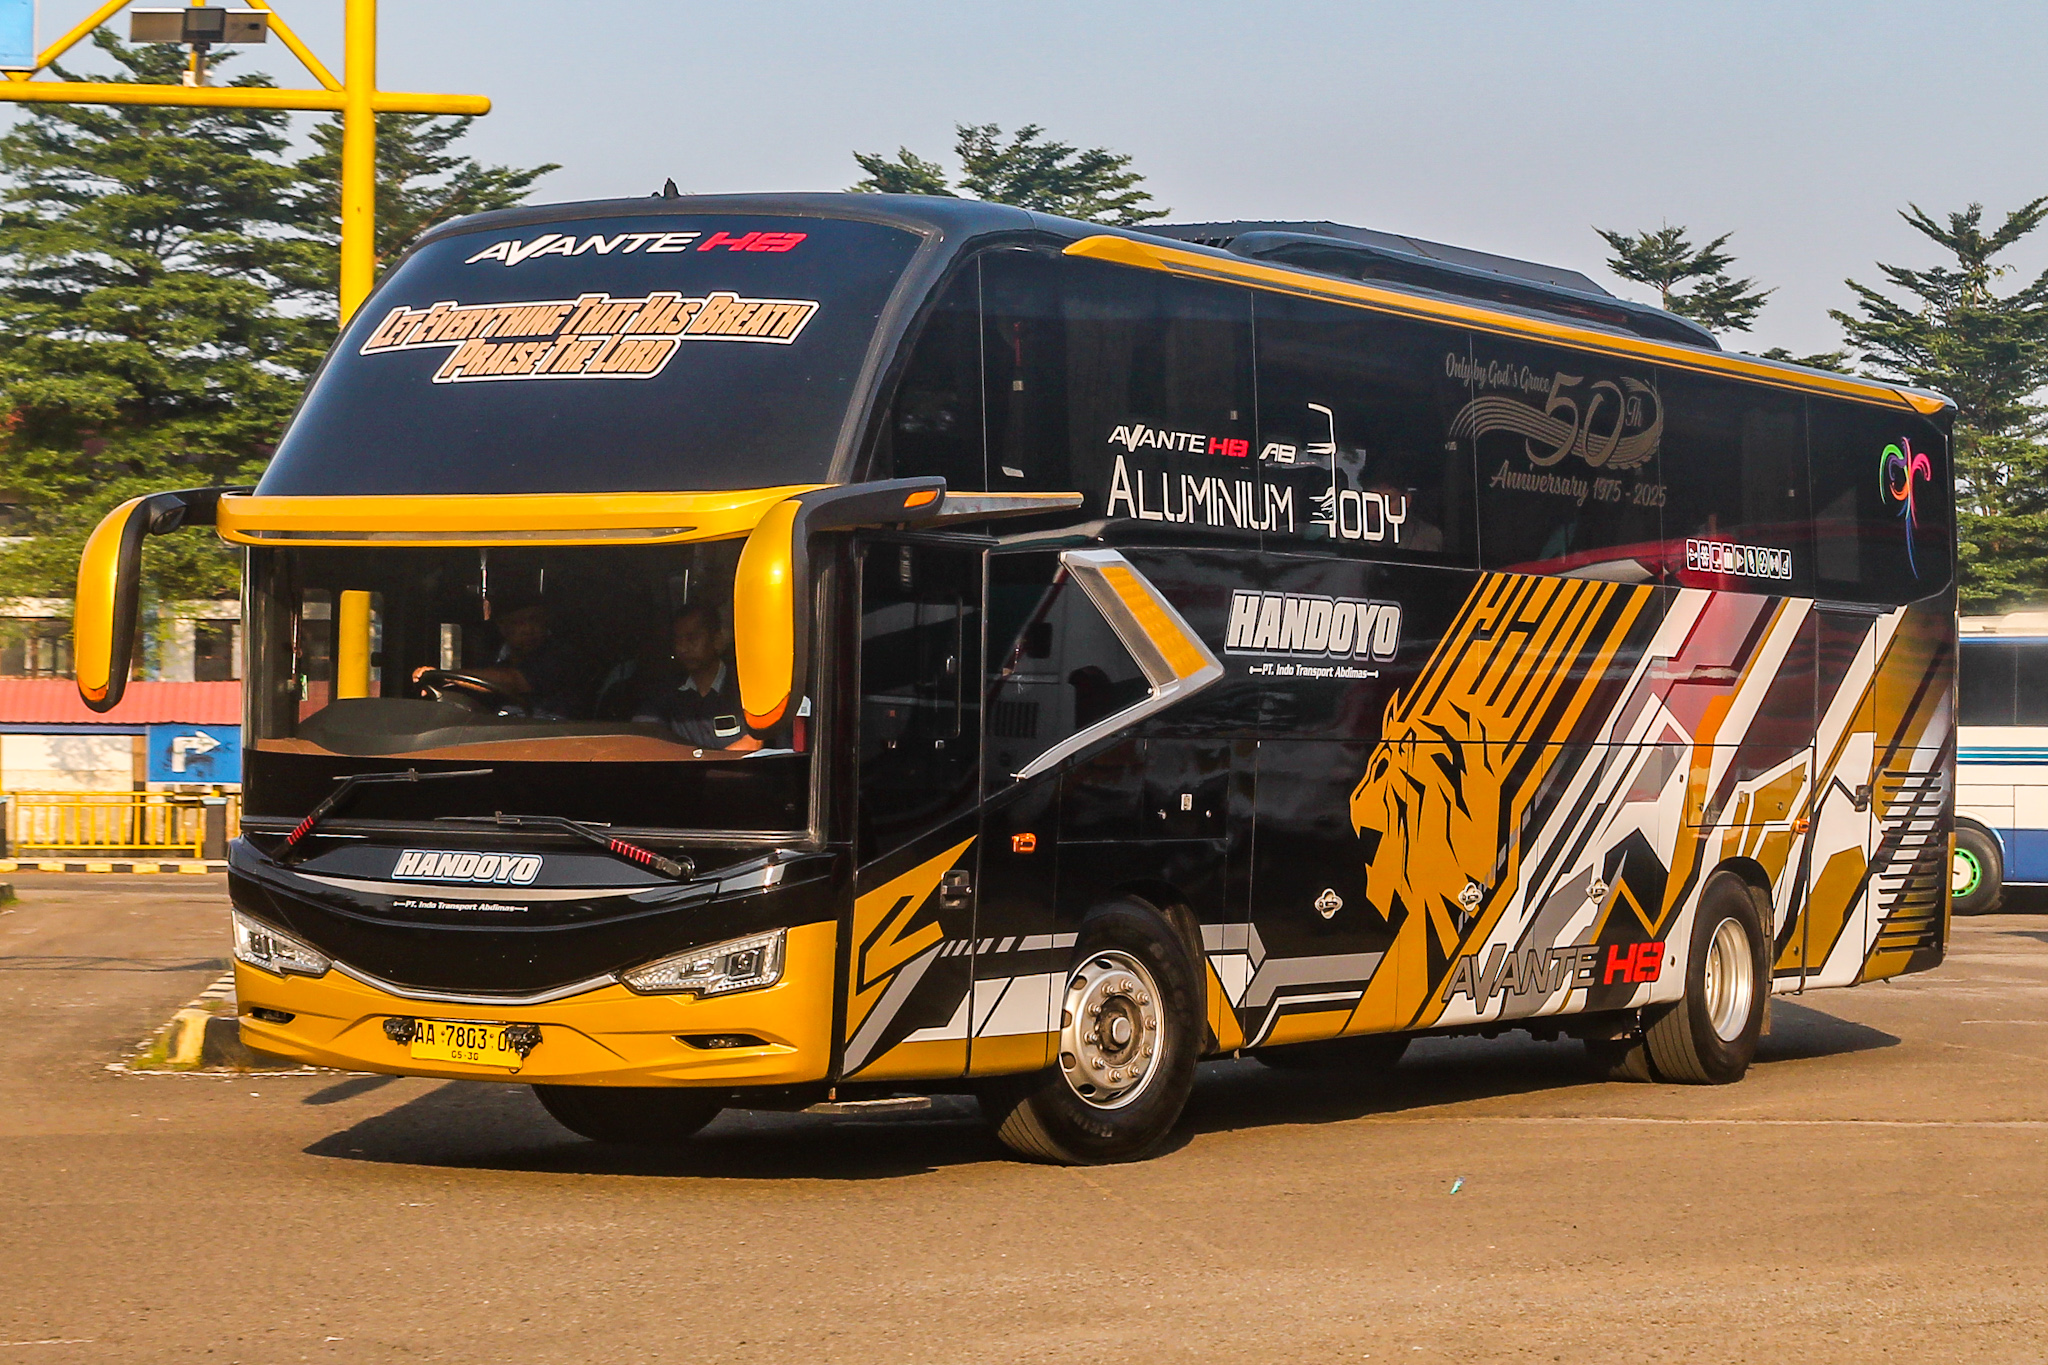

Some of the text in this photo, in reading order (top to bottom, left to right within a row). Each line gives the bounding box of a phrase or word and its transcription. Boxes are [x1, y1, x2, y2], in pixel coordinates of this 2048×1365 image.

[465, 232, 701, 266] AVANTE
[408, 305, 574, 344] EVERYTHING
[559, 297, 643, 335] THAT
[625, 296, 703, 335] HAS
[686, 296, 811, 338] BREATH
[441, 338, 553, 378] PRAISE
[585, 334, 676, 373] LORD
[1473, 358, 1487, 389] by
[1108, 424, 1206, 452] AVANTE
[1106, 454, 1294, 533] ALUMINIUM
[1489, 459, 1589, 507] Anniversary
[1592, 477, 1623, 502] 1975
[1633, 483, 1668, 508] 2025
[1225, 593, 1402, 658] HANDOYO
[1261, 662, 1368, 680] PT. Indo Transport Abdimas
[394, 851, 541, 882] HANDOYO
[404, 899, 515, 912] PT. Indo Transport Abdimas
[1441, 944, 1600, 1015] AVANTE
[414, 1022, 435, 1046] AA
[445, 1025, 488, 1050] 7803
